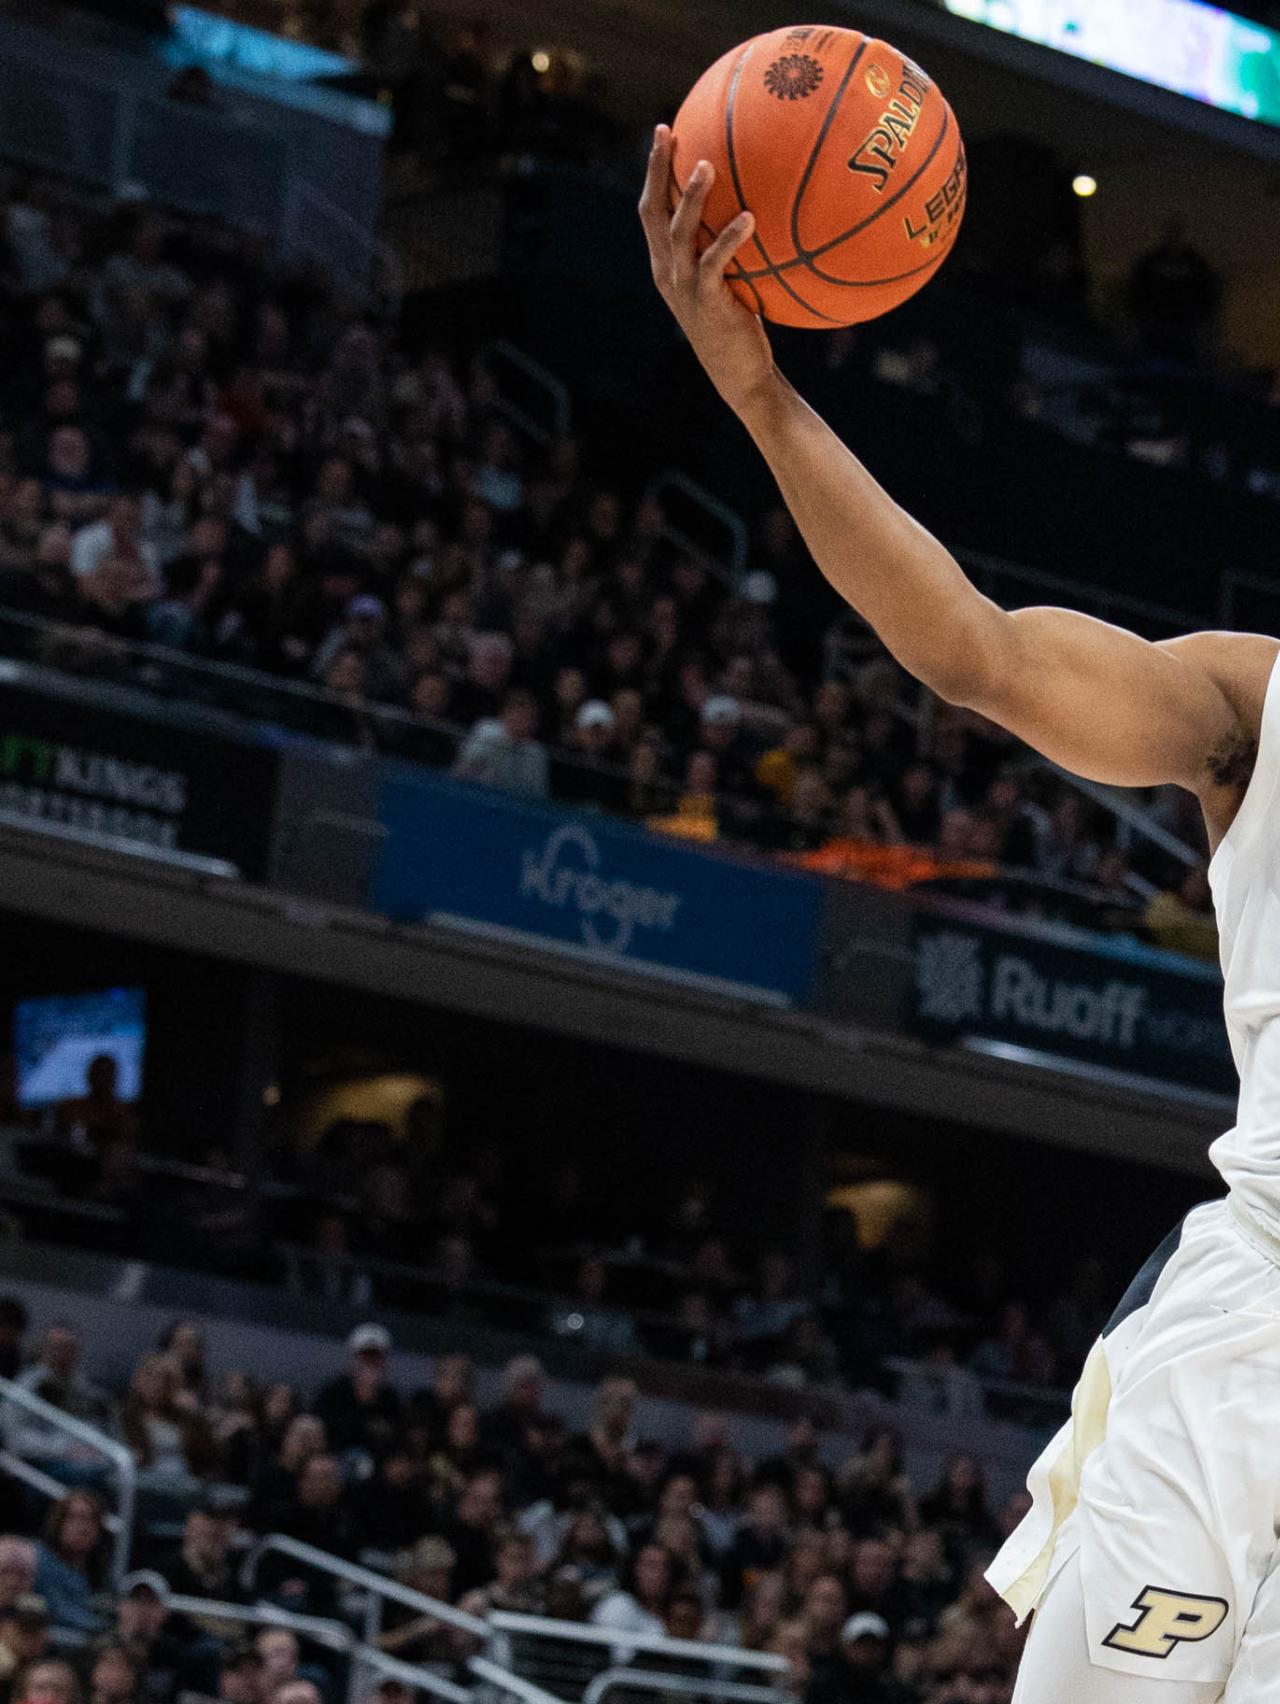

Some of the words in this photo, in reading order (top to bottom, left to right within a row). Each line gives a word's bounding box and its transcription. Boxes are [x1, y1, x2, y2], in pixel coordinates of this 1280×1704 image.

[521, 823, 681, 952] Kroger
[990, 953, 1147, 1047] Ruoff
[1101, 1585, 1229, 1659] P
